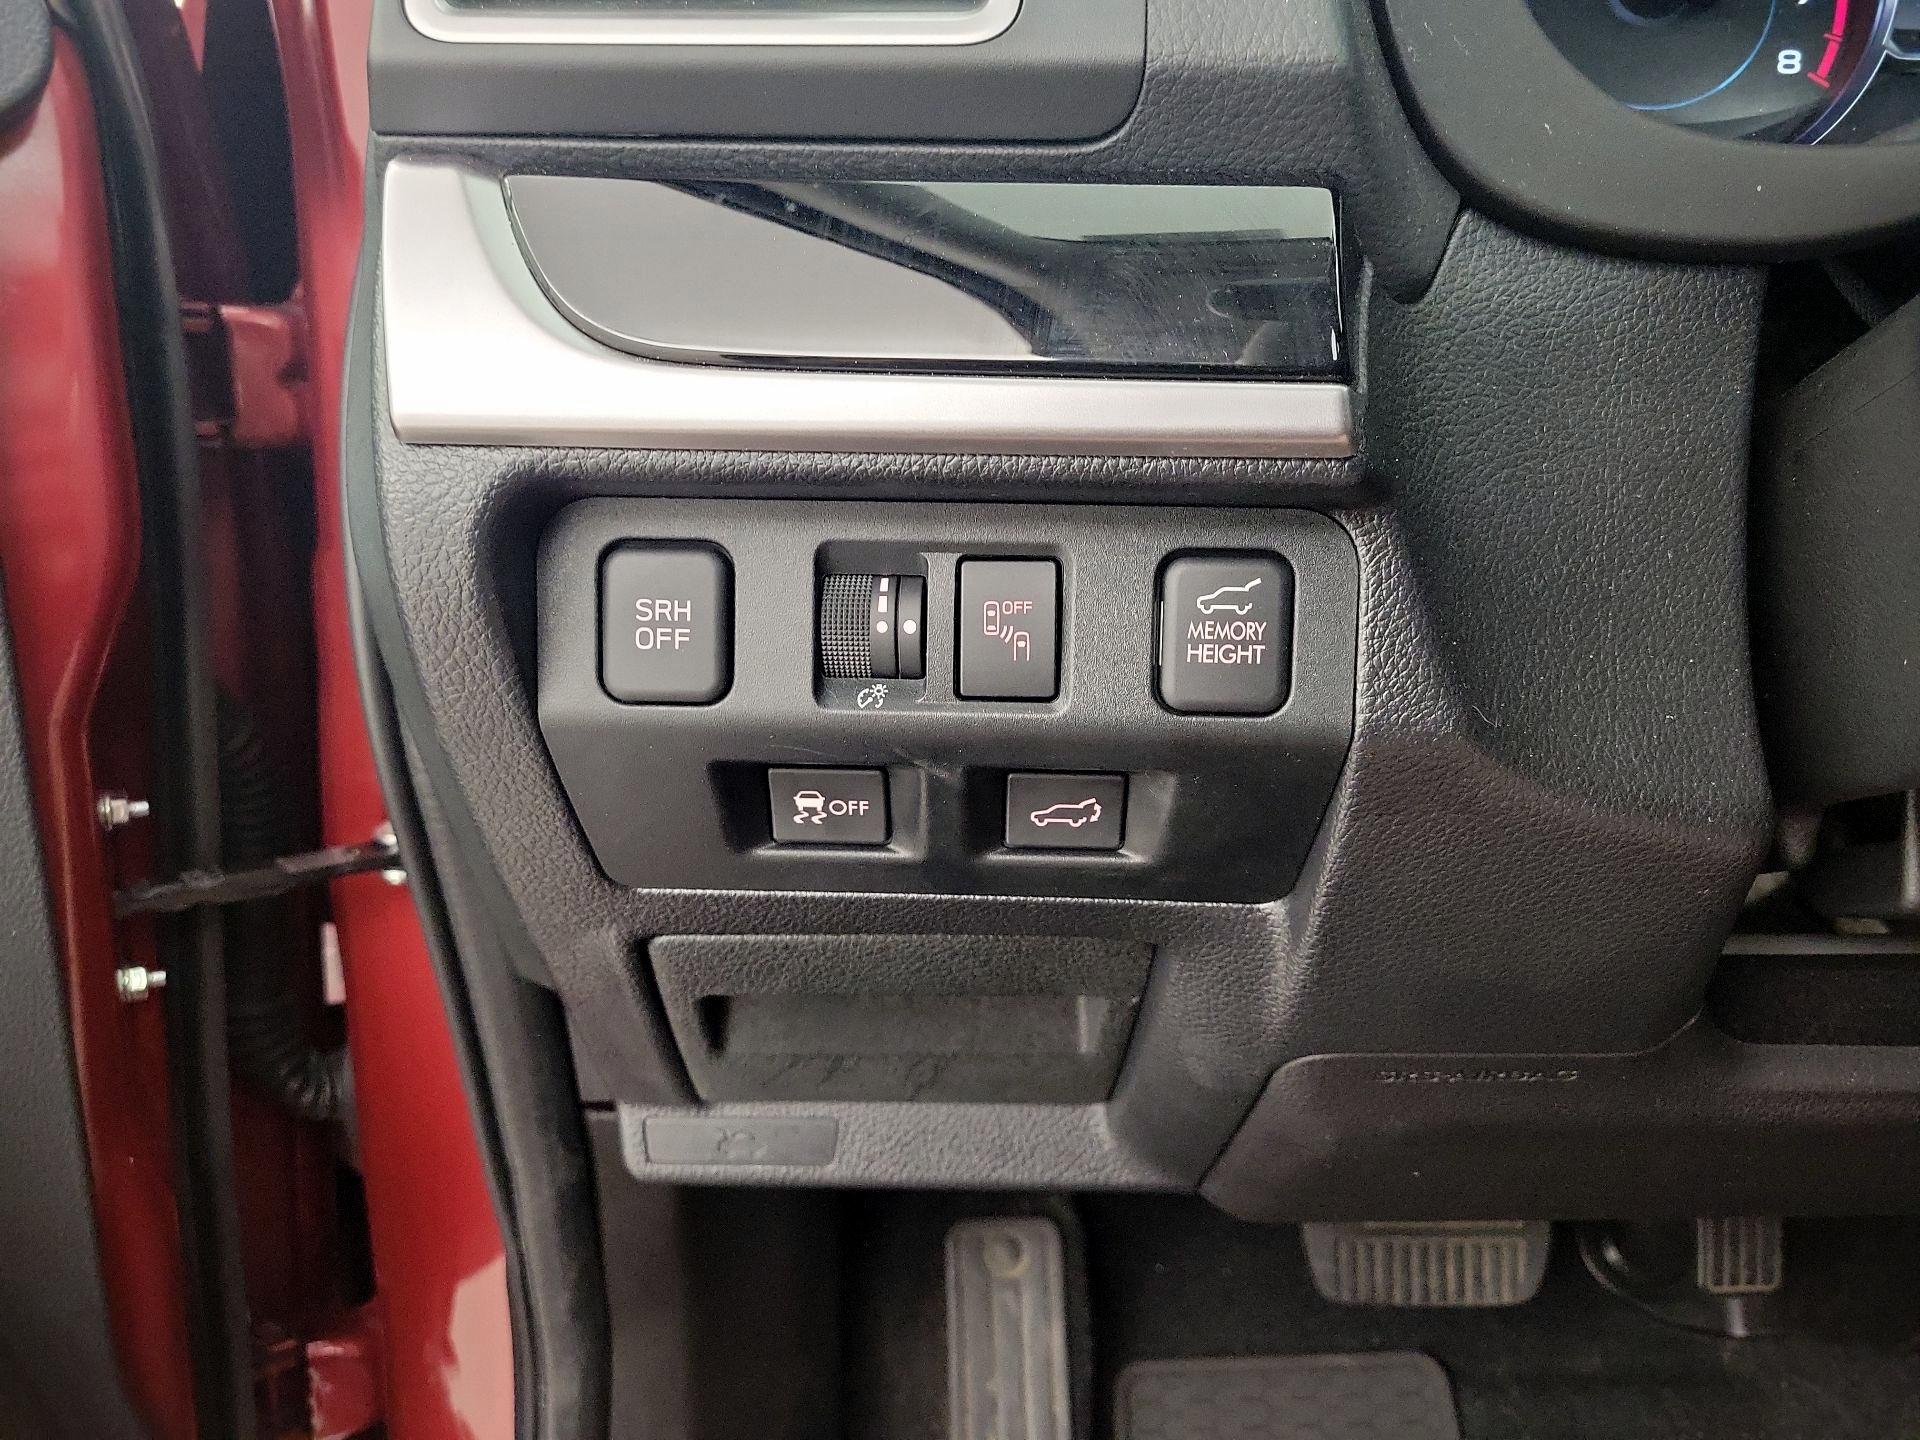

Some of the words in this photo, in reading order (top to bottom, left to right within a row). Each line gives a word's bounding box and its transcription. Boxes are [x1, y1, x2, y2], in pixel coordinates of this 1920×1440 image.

[1777, 49, 1801, 75] 8
[635, 598, 691, 622] SRH
[1002, 600, 1033, 615] OFF
[635, 626, 691, 650] OFF
[1187, 620, 1267, 641] MEMORY
[1186, 643, 1266, 665] HEIGHT
[828, 799, 870, 816] OFF
